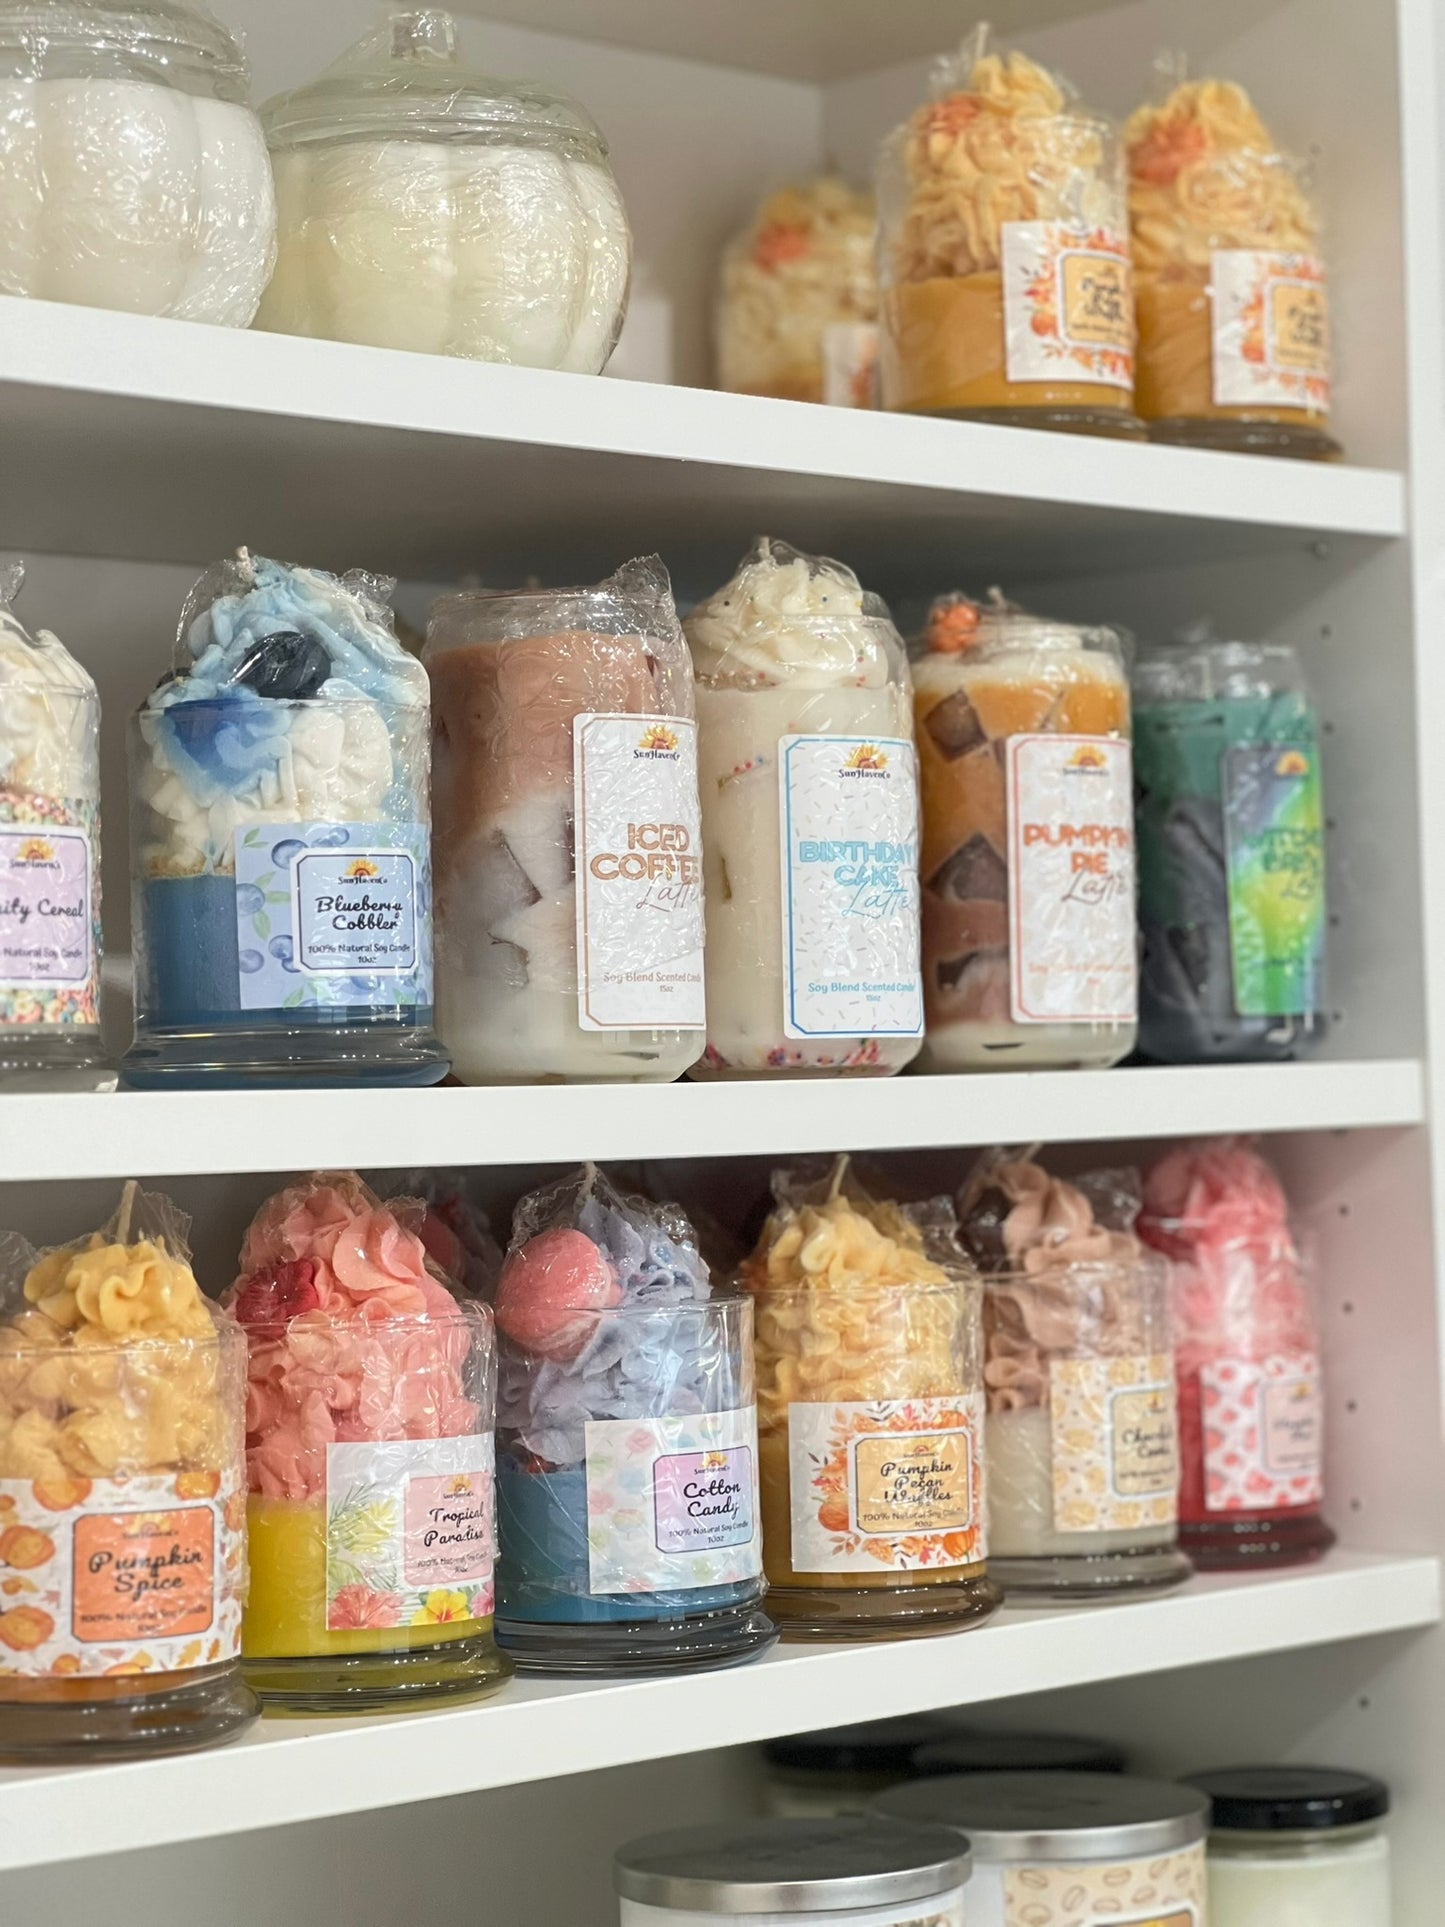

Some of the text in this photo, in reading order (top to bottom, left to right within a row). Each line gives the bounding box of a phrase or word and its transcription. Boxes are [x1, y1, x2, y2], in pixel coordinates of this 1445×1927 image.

[838, 768, 891, 780] SunHavenCo
[627, 822, 690, 852] ICED
[799, 841, 914, 865] BIRTHDAY
[834, 864, 900, 888] CAKE
[37, 898, 84, 917] Cereal
[315, 894, 403, 919] Blueberry
[332, 912, 398, 931] Cobbler
[308, 944, 336, 954] 100%
[338, 943, 373, 953] Natural
[374, 943, 388, 955] Soy
[625, 972, 653, 982] Blend
[656, 972, 686, 983] Scented
[808, 982, 828, 994] Soy
[831, 982, 860, 992] Blend
[862, 982, 895, 992] Scented
[880, 1459, 953, 1480] Pumpkin
[683, 1478, 741, 1499] Cotton
[894, 1475, 944, 1491] Pecan
[429, 1501, 484, 1528] Tropical
[687, 1495, 739, 1520] Candy
[863, 1512, 890, 1521] 100%
[424, 1525, 484, 1547] Paradise
[88, 1544, 203, 1578] Pumpkin
[114, 1573, 183, 1602] Spice
